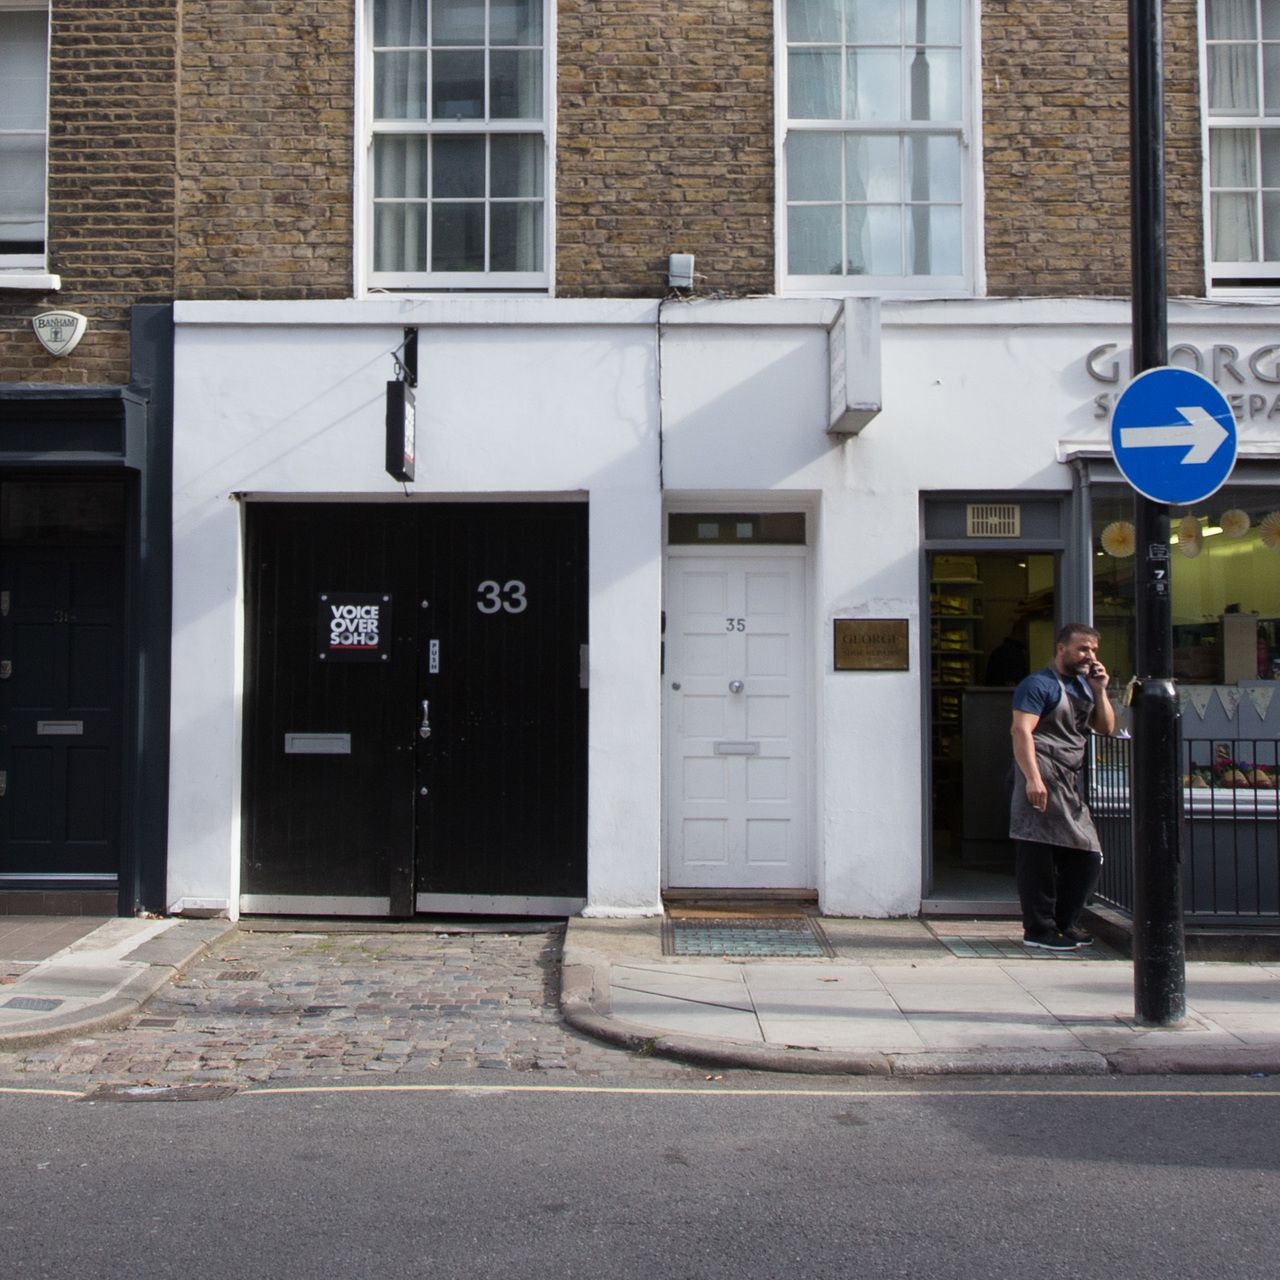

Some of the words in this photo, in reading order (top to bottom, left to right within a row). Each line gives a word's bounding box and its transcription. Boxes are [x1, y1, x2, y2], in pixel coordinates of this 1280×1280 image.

[38, 317, 75, 329] BANHAM
[476, 580, 528, 614] 33
[330, 605, 380, 619] VOICE
[330, 619, 379, 633] OVER
[725, 618, 746, 632] 35
[329, 632, 379, 645] SOHO
